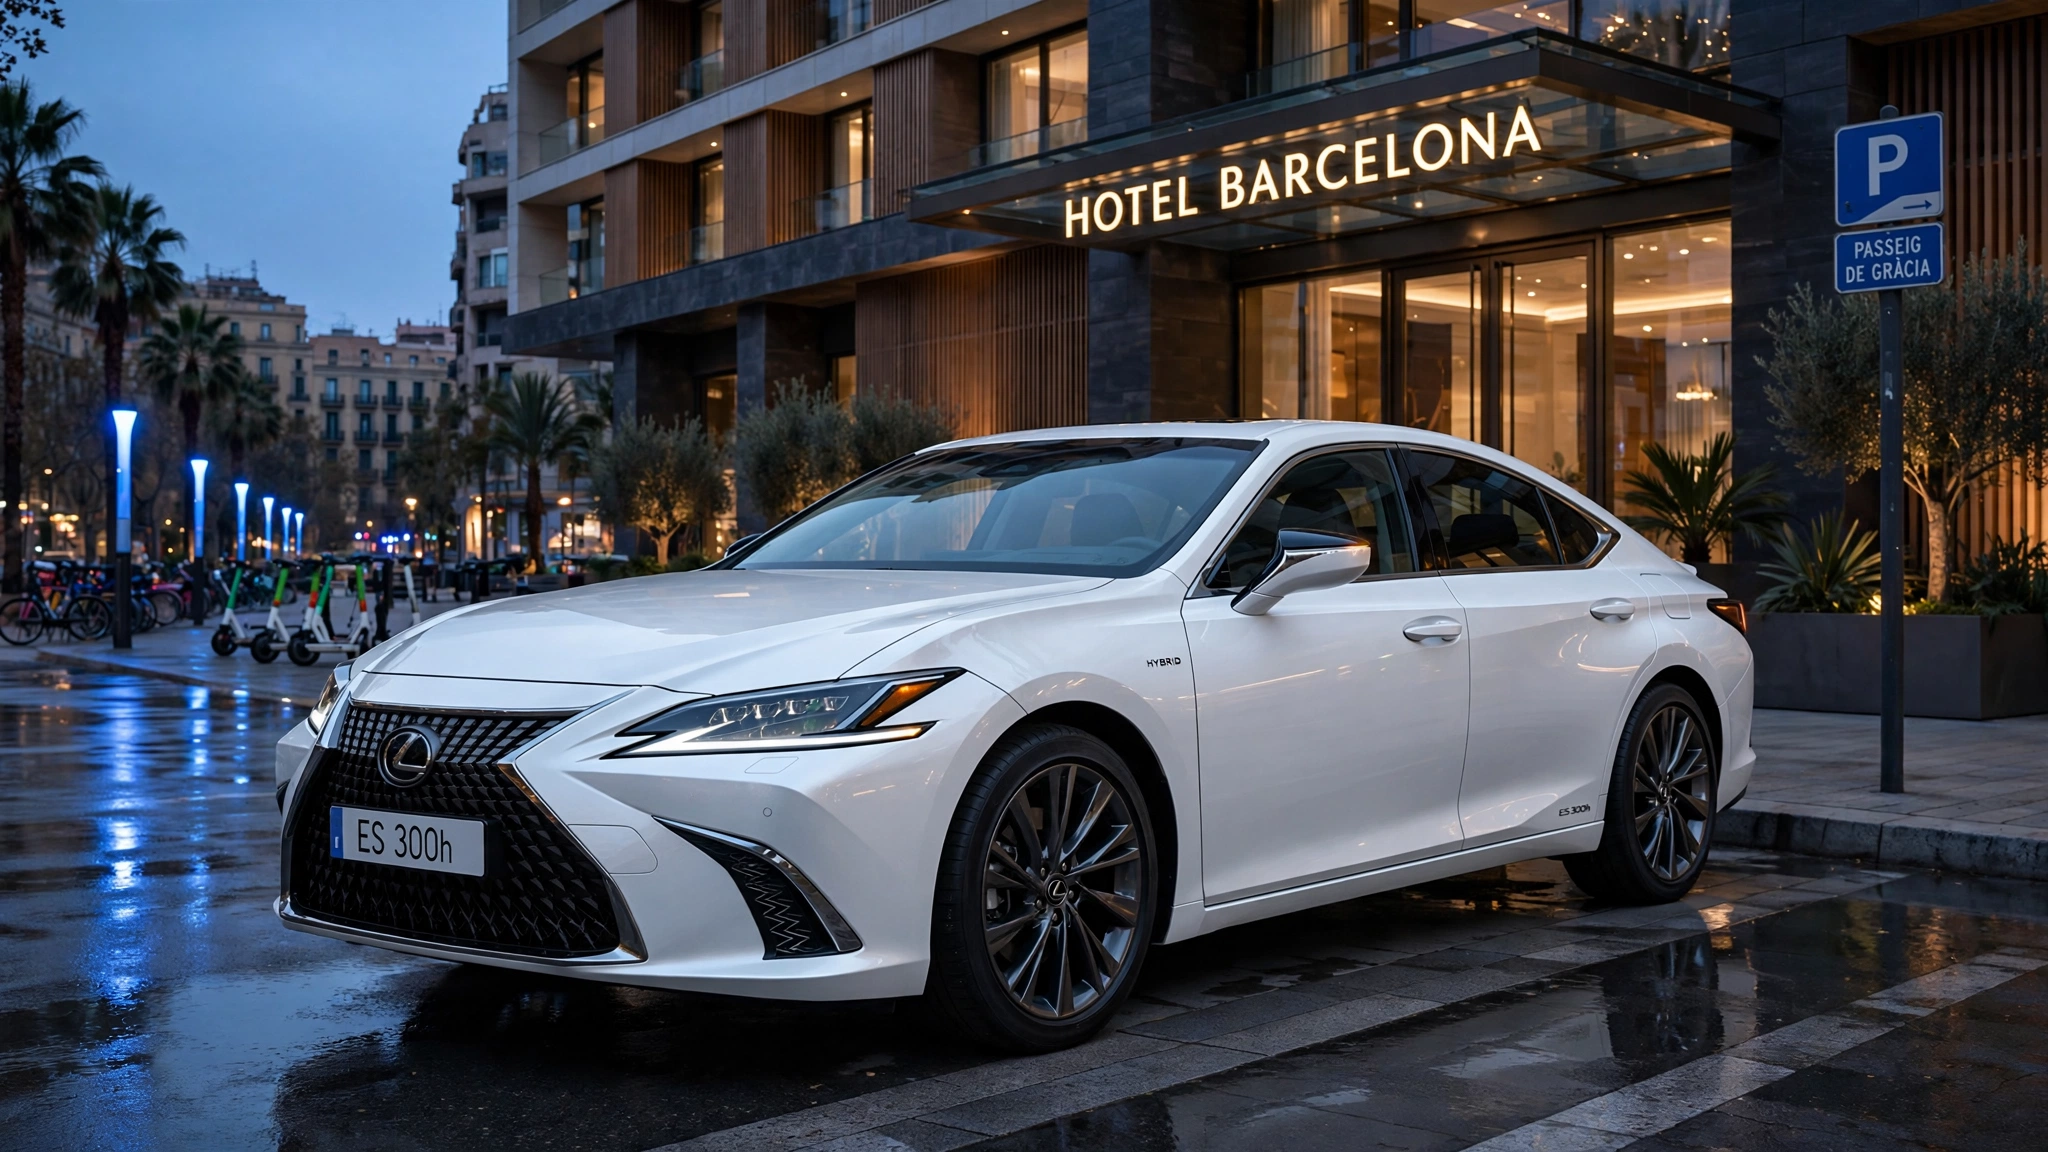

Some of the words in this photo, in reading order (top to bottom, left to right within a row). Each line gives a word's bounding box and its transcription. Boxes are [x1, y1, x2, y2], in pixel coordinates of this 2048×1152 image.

[1065, 176, 1198, 238] HOTEL
[1220, 105, 1542, 210] BARCELONA
[1868, 134, 1909, 197] P
[1854, 235, 1922, 259] PASSEIG
[1845, 265, 1865, 283] DE
[1871, 257, 1931, 281] GRÀCIA
[1146, 656, 1182, 668] HYBRID
[1558, 807, 1570, 817] ES
[1570, 803, 1591, 815] 300h
[357, 818, 385, 855] ES
[394, 823, 453, 864] 300h
